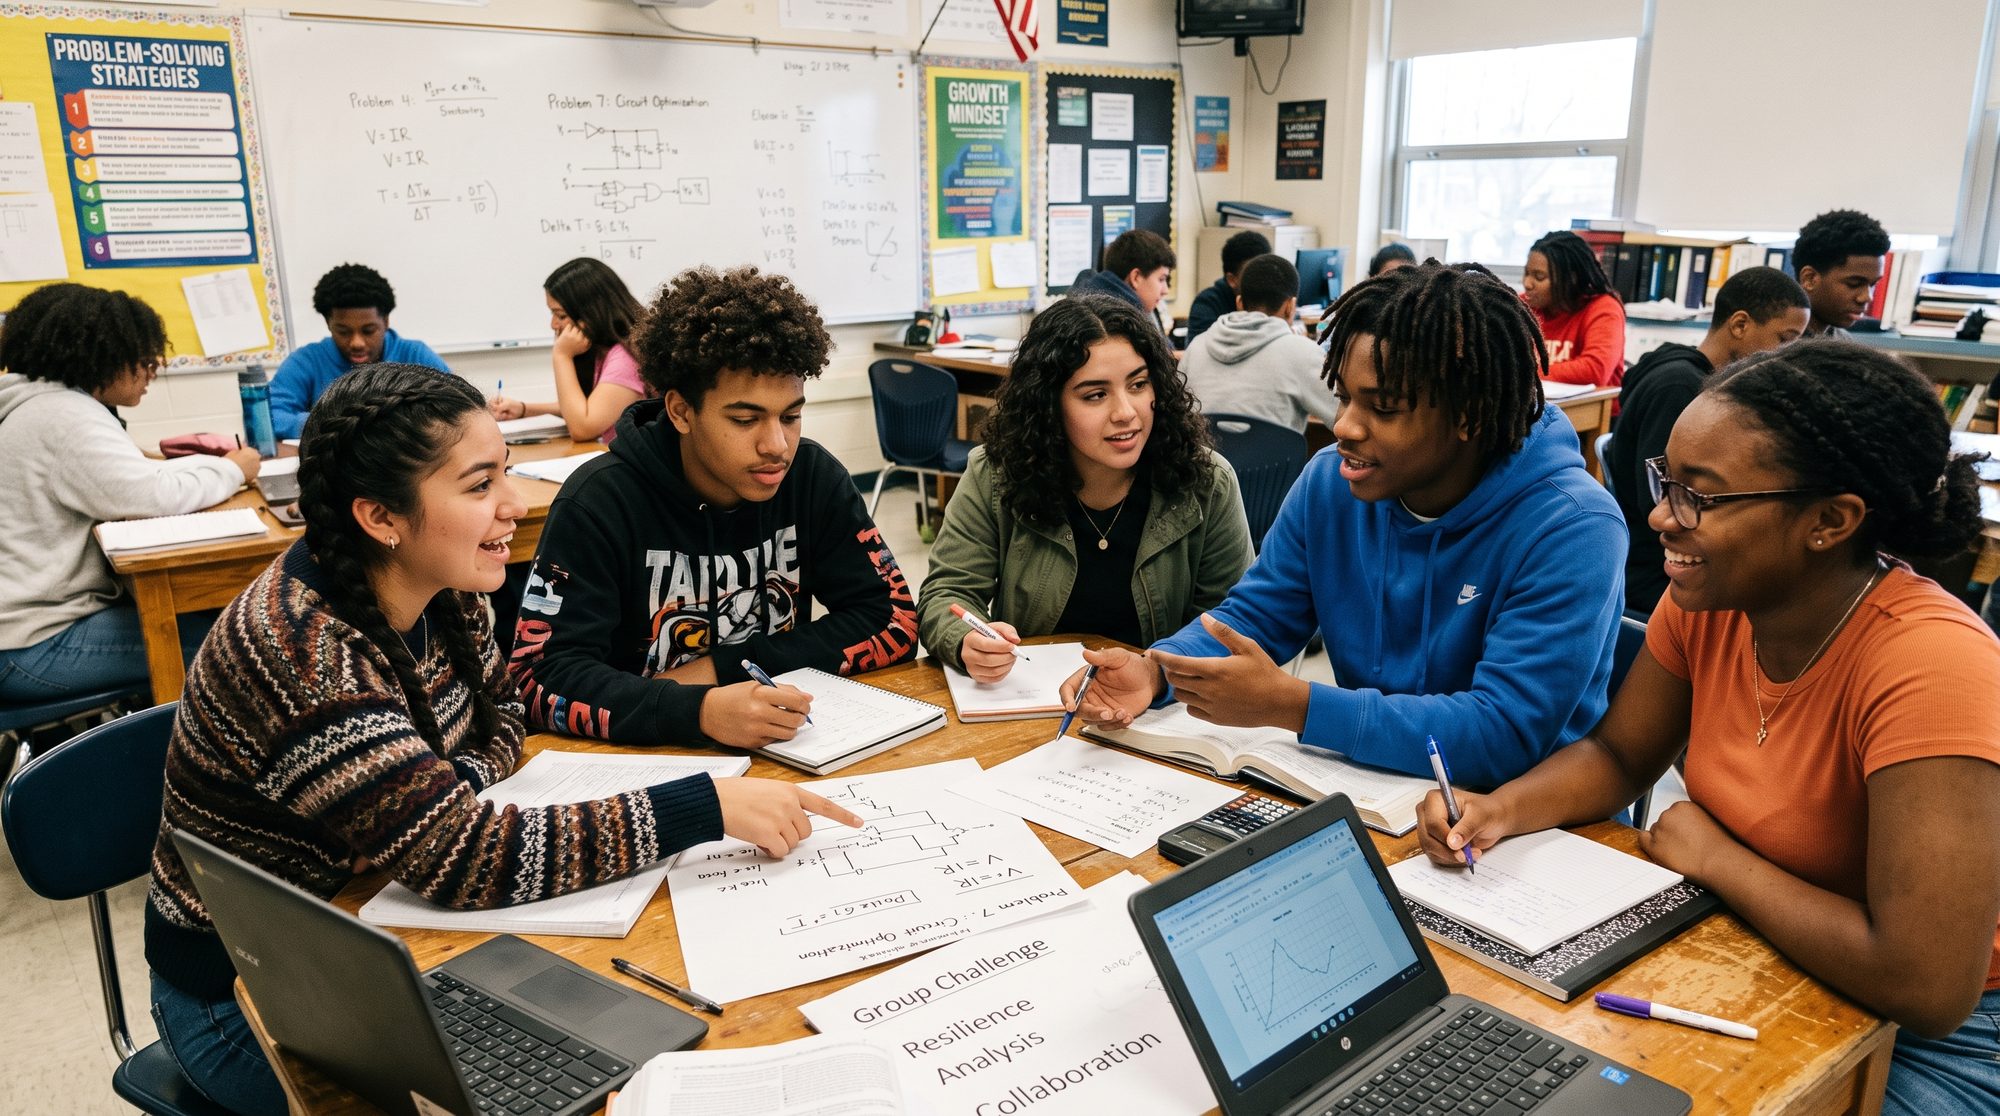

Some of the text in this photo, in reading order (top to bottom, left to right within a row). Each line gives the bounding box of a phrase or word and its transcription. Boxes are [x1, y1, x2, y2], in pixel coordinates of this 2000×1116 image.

[53, 38, 226, 67] PROBLEM-SOLVING
[91, 64, 200, 89] STRATEGIES
[350, 92, 394, 108] Problem
[548, 93, 592, 109] Problem
[948, 81, 1010, 104] GROWTH
[71, 102, 80, 115] 1
[948, 103, 1010, 126] MINDSET
[77, 138, 87, 150] 2
[82, 163, 92, 177] 3
[86, 187, 95, 200] 4
[90, 211, 100, 225] 5
[94, 242, 104, 256] 6
[997, 887, 1068, 913] Problem
[903, 916, 959, 937] Circuit
[798, 931, 897, 961] Optimization
[853, 985, 932, 1025] Group
[935, 936, 1049, 991] Challenge
[902, 998, 1035, 1058] Resilience
[936, 1029, 1045, 1085] Analysis
[976, 1030, 1162, 1116] Collaboration
